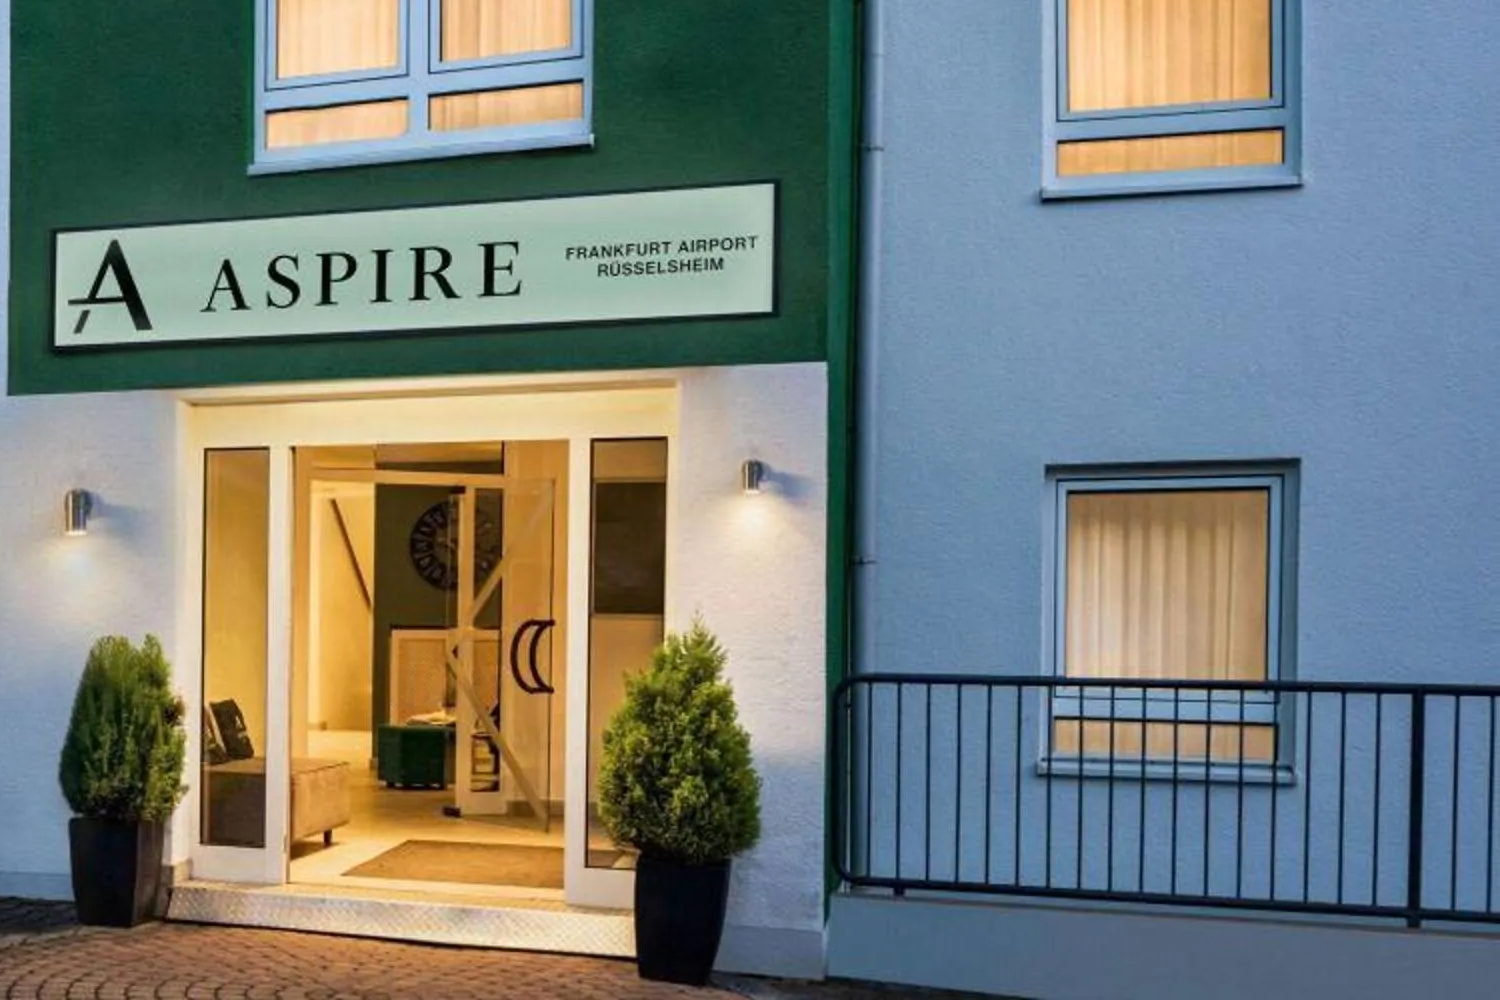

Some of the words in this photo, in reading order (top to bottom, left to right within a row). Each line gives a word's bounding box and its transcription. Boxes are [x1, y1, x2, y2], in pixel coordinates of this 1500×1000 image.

[565, 241, 672, 261] FRANKFURT
[677, 235, 759, 254] AIRPORT
[597, 257, 725, 277] RÜSSELSHEIM
[68, 238, 152, 334] A
[201, 241, 522, 312] ASPIRE
